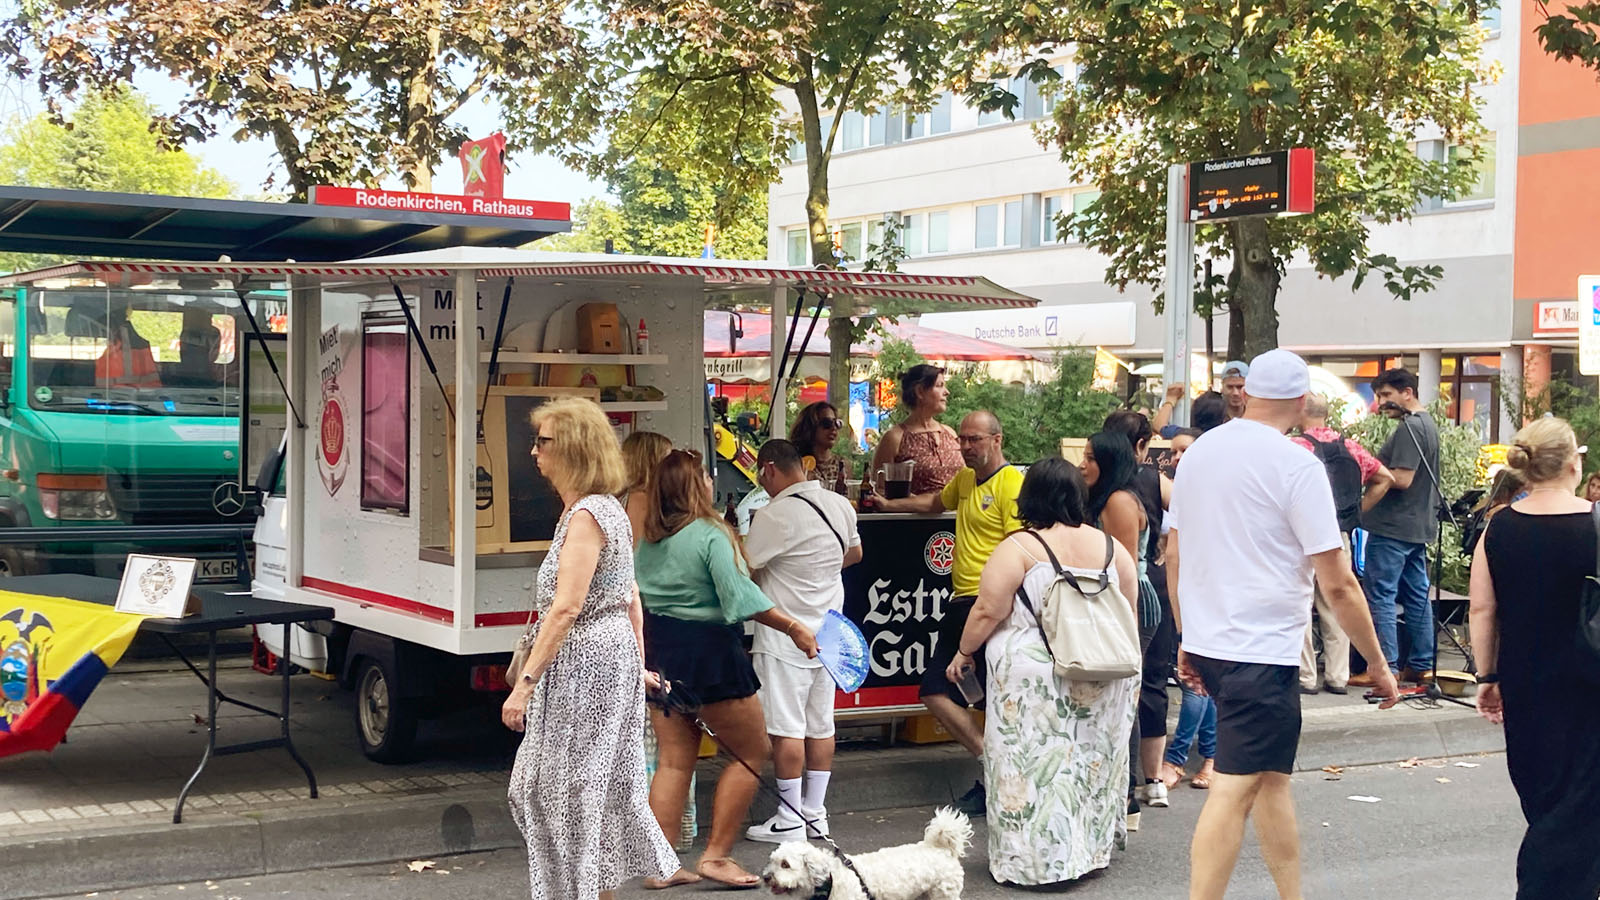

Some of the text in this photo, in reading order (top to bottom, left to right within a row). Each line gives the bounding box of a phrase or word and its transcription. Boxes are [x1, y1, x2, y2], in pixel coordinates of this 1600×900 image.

[1204, 157, 1272, 172] Rodenkirchen Rathaus
[356, 191, 534, 217] Rodenkirchen, Rathaus
[319, 327, 338, 356] Miet
[975, 325, 1041, 340] Deutsche Bank
[321, 355, 342, 381] mich
[202, 561, 238, 576] K GM
[863, 578, 955, 624] Estr
